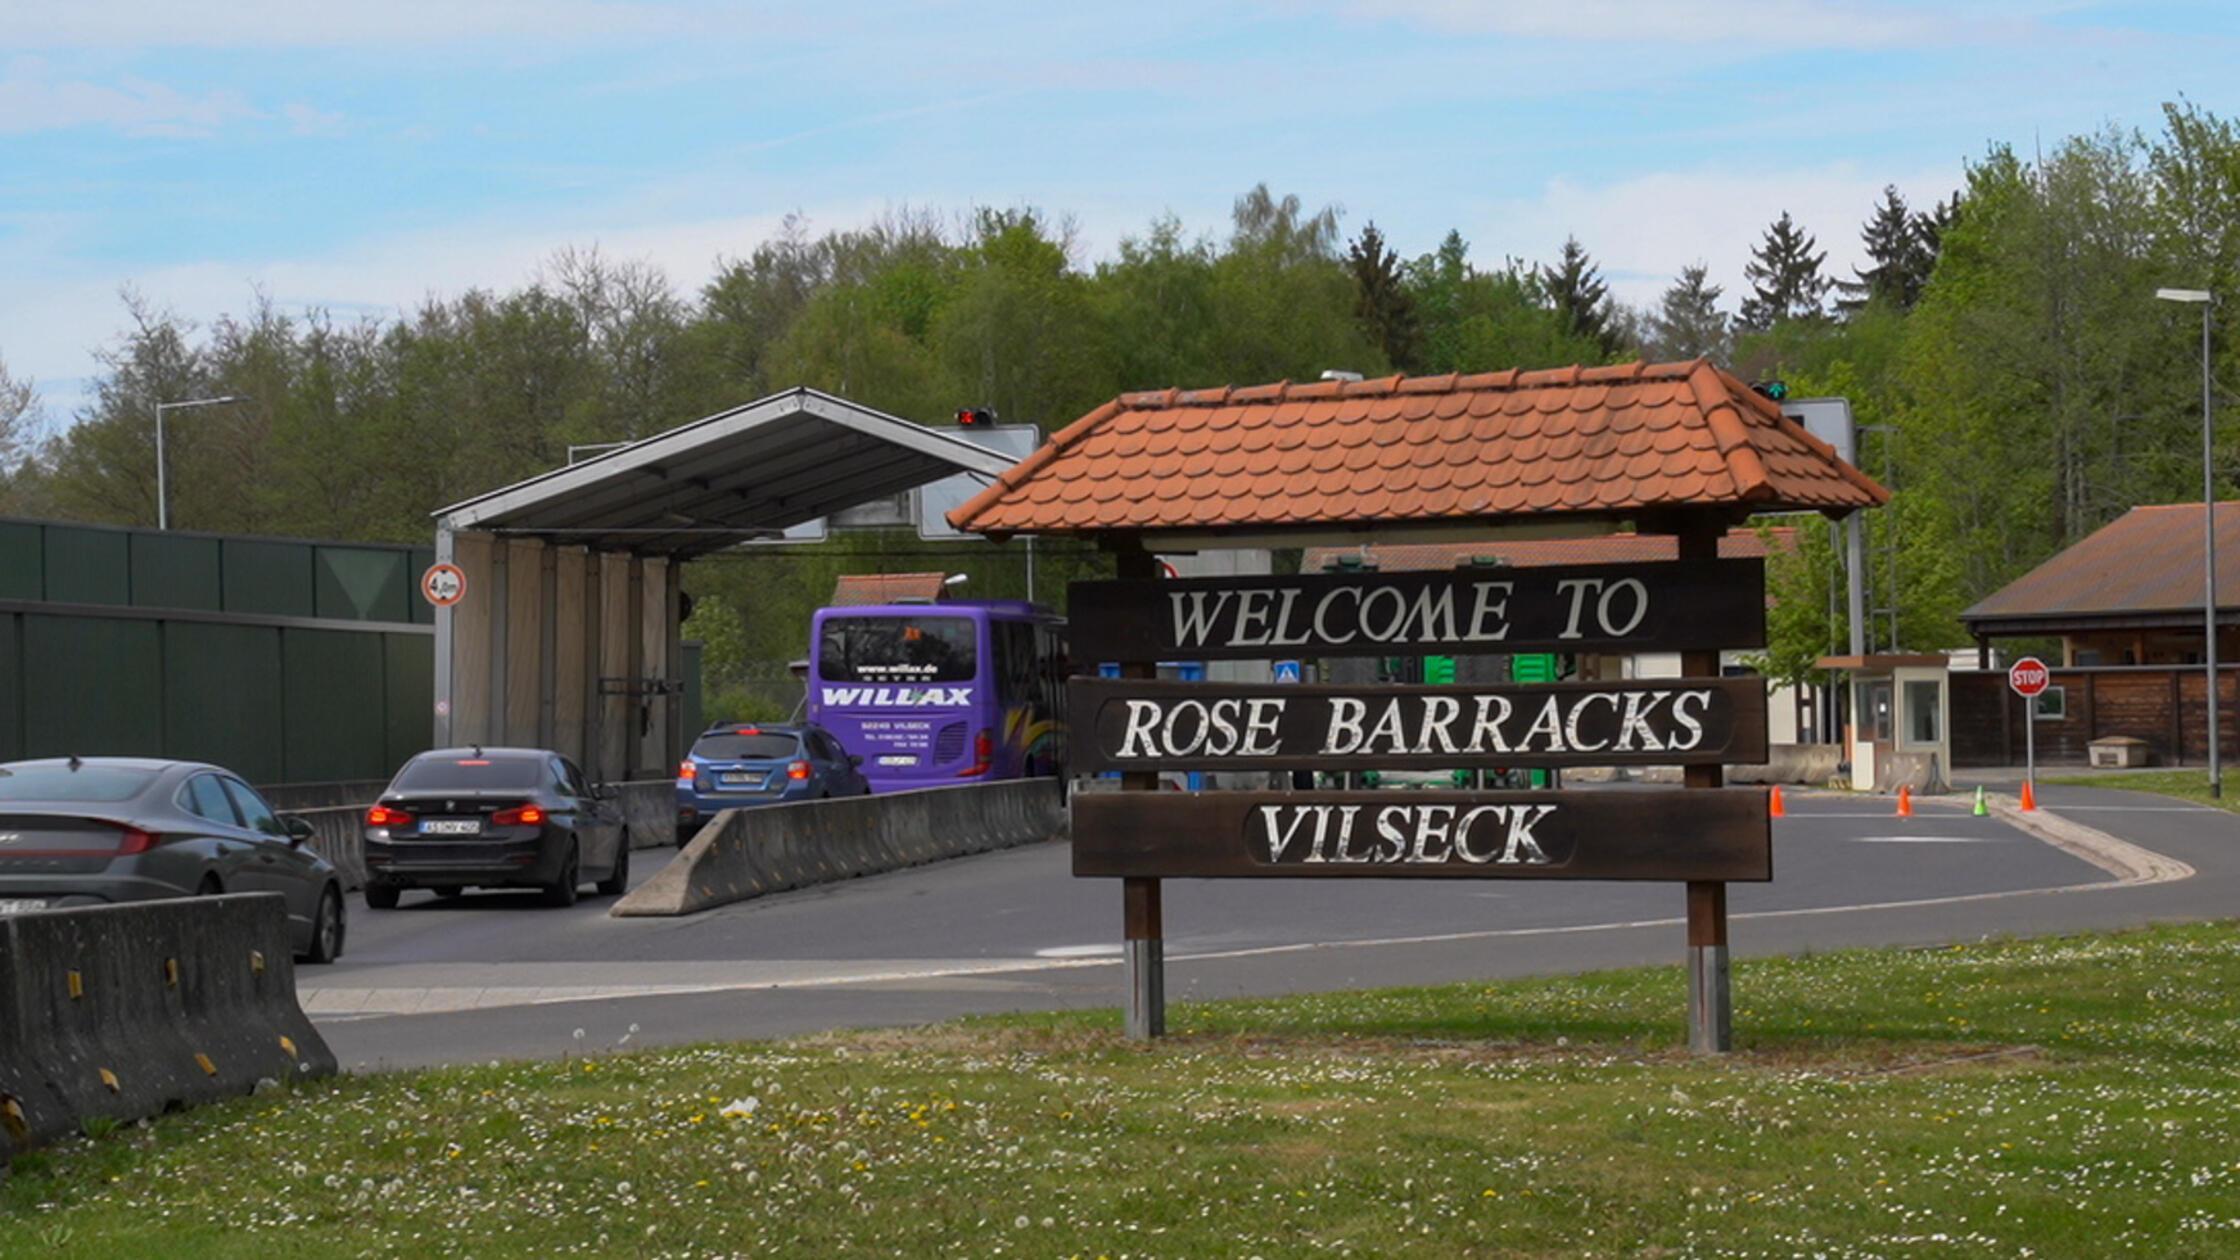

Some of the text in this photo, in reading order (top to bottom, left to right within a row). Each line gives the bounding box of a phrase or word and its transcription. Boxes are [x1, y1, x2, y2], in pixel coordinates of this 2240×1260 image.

[1168, 578, 1648, 648] WELCOME TO
[821, 688, 974, 706] WILLAX
[2013, 669, 2045, 686] STOP
[1115, 690, 1712, 758] ROSE BARRACKS
[1259, 804, 1558, 865] VILSECK
